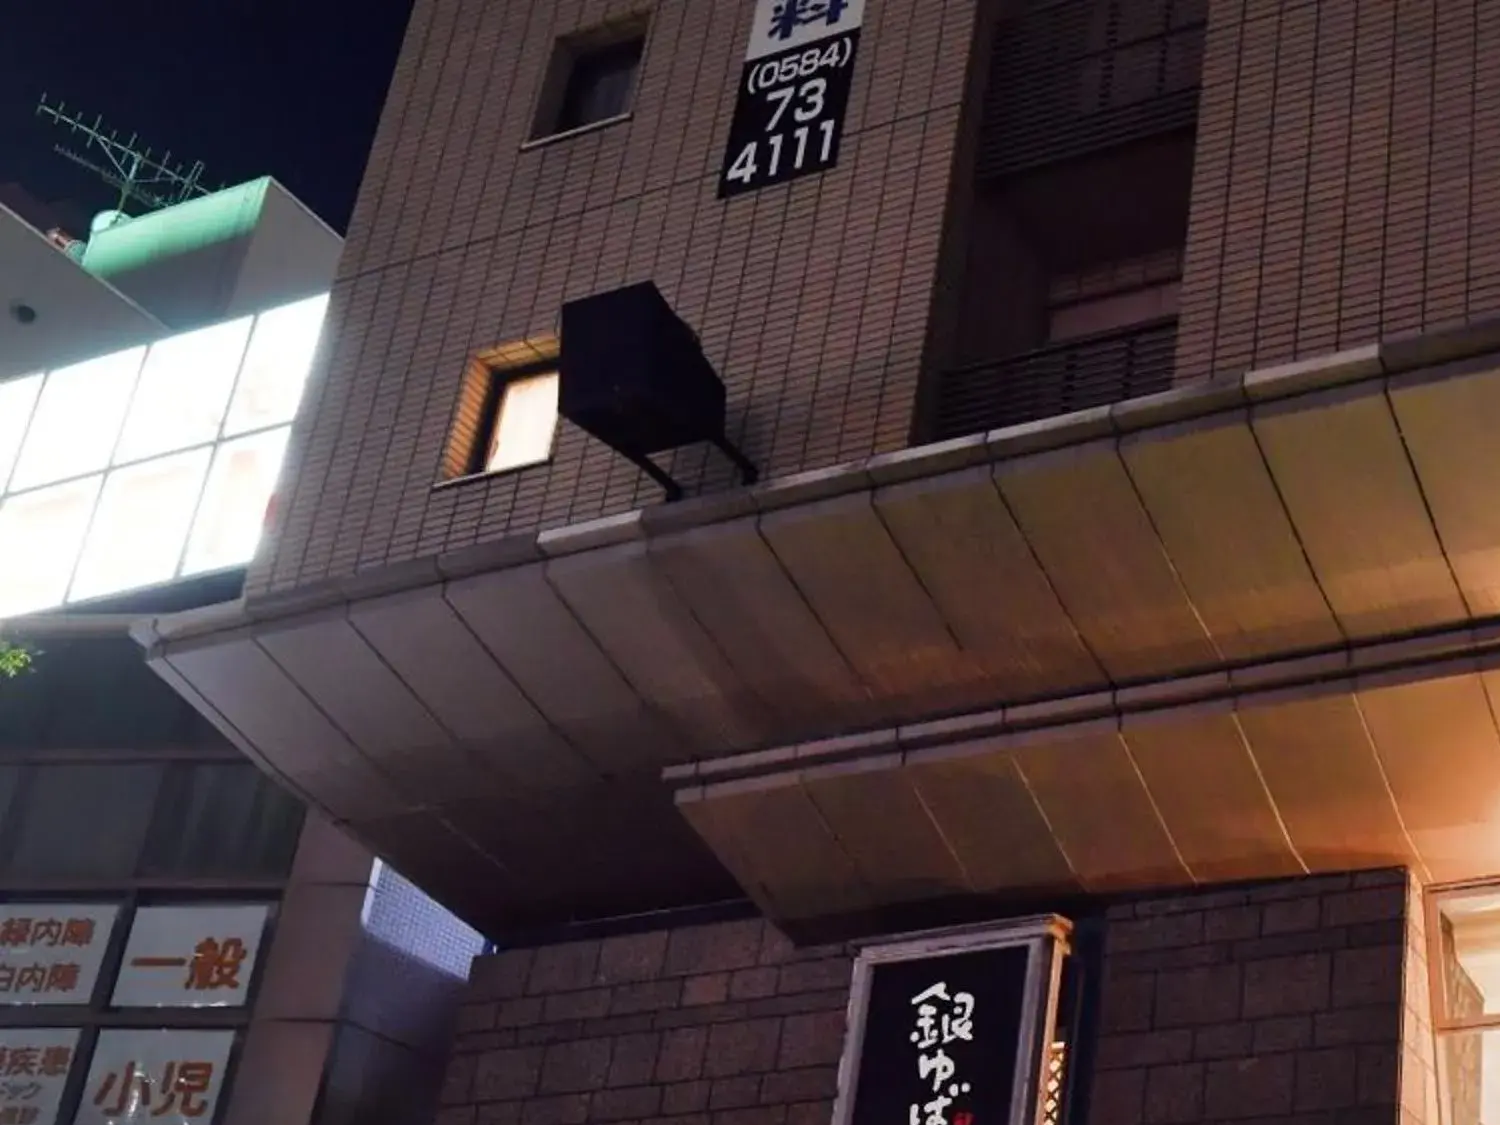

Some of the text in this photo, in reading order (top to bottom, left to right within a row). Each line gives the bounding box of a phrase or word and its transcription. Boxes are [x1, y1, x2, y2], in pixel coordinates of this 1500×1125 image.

[747, 37, 852, 94] (0584)
[765, 78, 827, 132] 73
[726, 119, 835, 183] 4111
[131, 937, 247, 990] 一般
[93, 1060, 214, 1117] 小児
